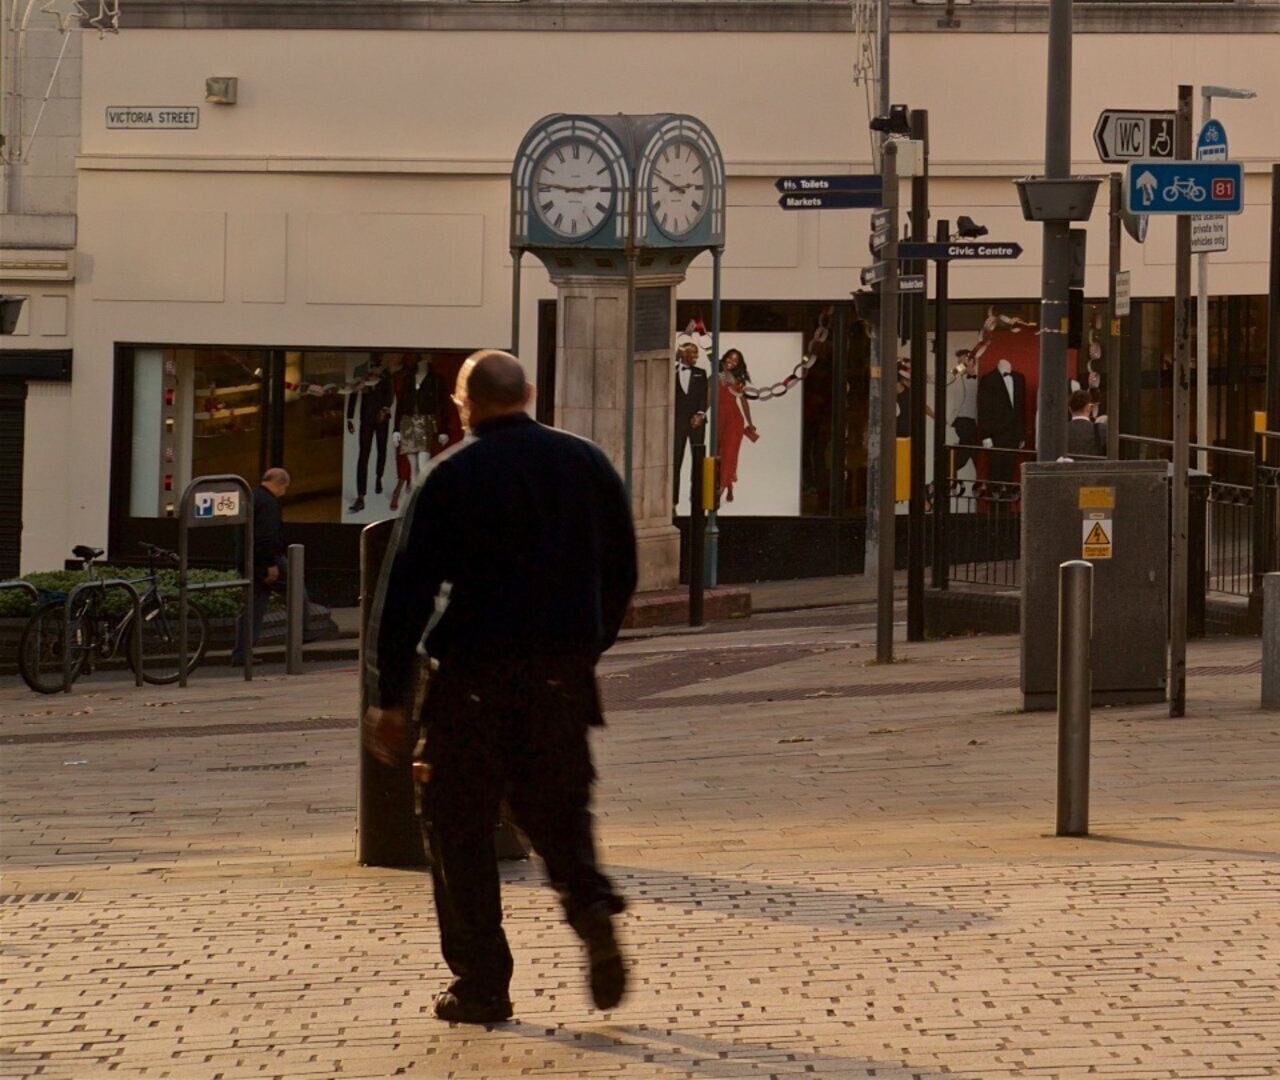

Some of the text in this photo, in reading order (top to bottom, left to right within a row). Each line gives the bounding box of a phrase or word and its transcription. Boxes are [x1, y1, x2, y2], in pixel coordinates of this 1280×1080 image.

[109, 112, 196, 123] VICTORIA STREET
[1119, 122, 1141, 152] WC
[800, 180, 829, 189] Toilets
[1215, 183, 1232, 196] 81
[786, 198, 822, 206] Markets
[948, 247, 1013, 255] Civic Centre
